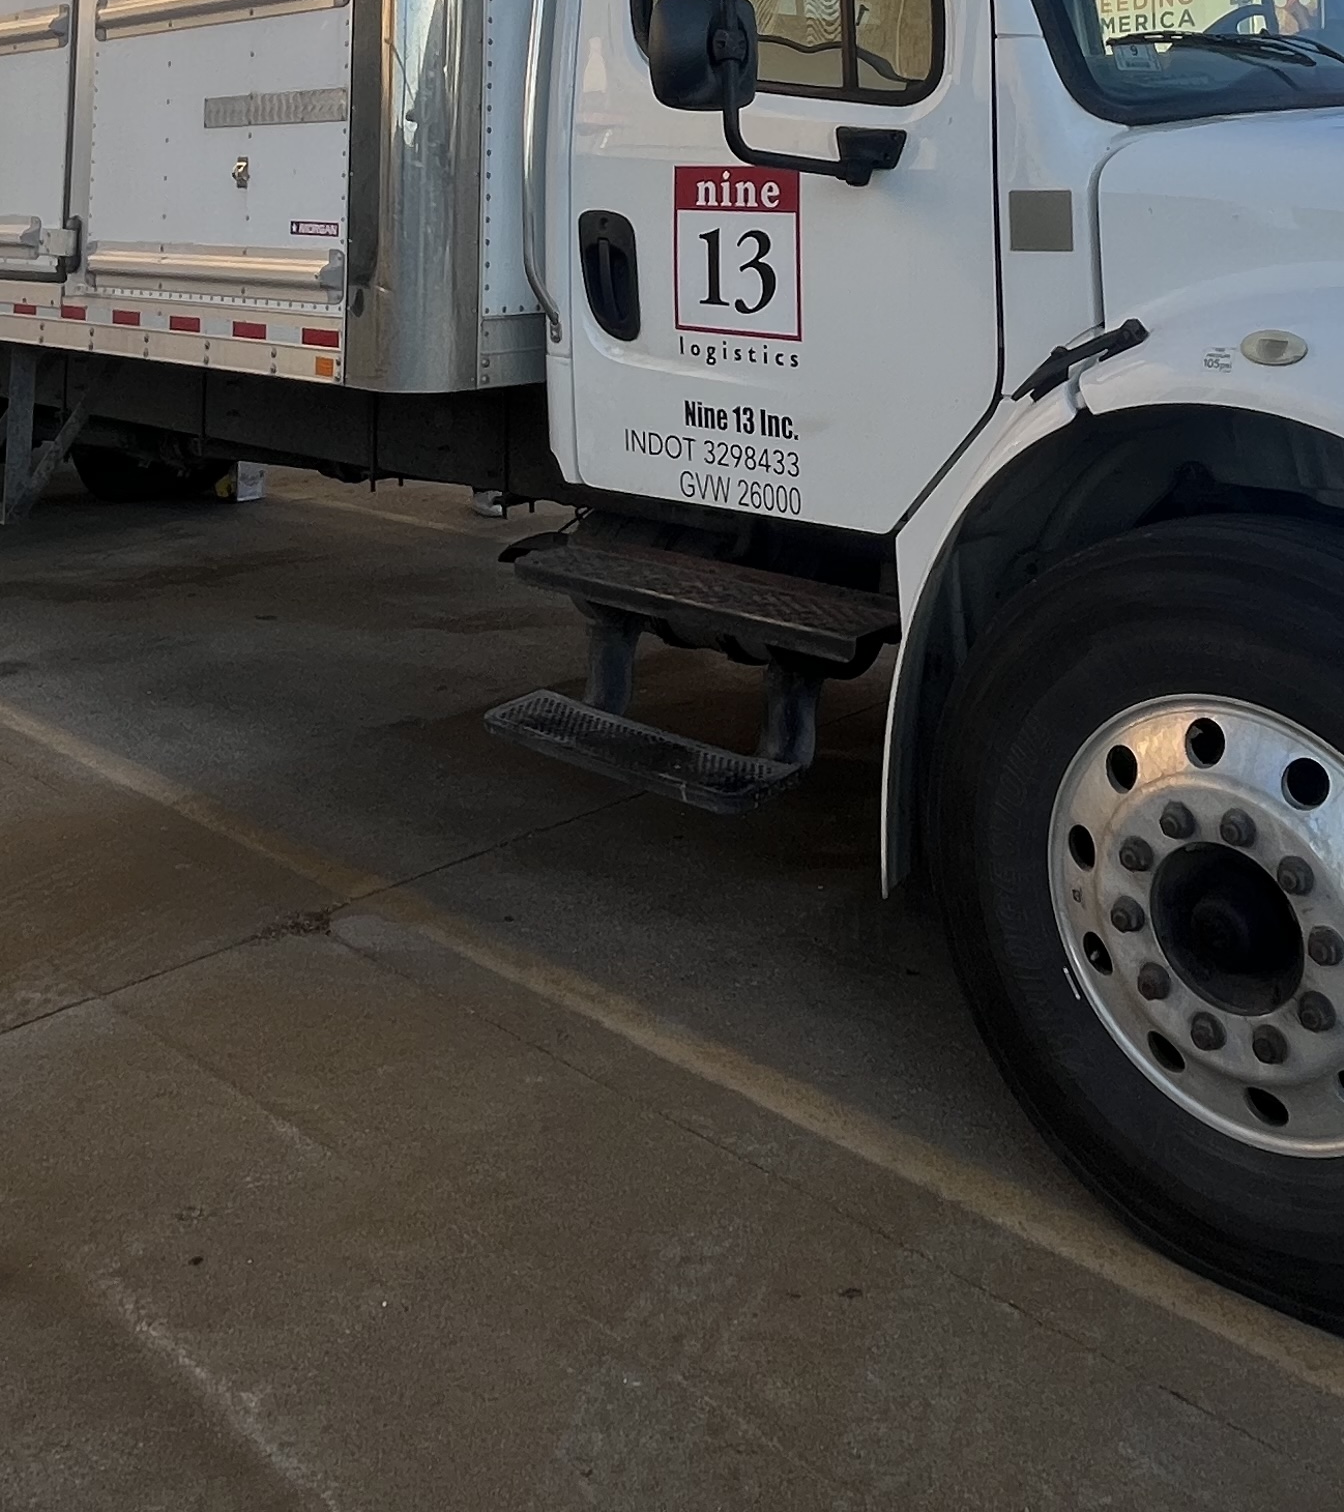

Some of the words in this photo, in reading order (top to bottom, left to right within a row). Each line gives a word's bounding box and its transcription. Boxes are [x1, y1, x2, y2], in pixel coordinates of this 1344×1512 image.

[1100, 8, 1196, 34] MERICA
[695, 170, 781, 208] nine
[698, 228, 777, 315] 13
[679, 335, 800, 368] logistics
[1203, 358, 1220, 369] 105
[684, 400, 729, 431] Nine
[732, 406, 755, 435] 13
[760, 409, 800, 441] Inc.
[624, 428, 697, 462] INDOT
[703, 439, 800, 478] 3298433
[679, 470, 731, 504] GVW
[737, 478, 802, 516] 26000
